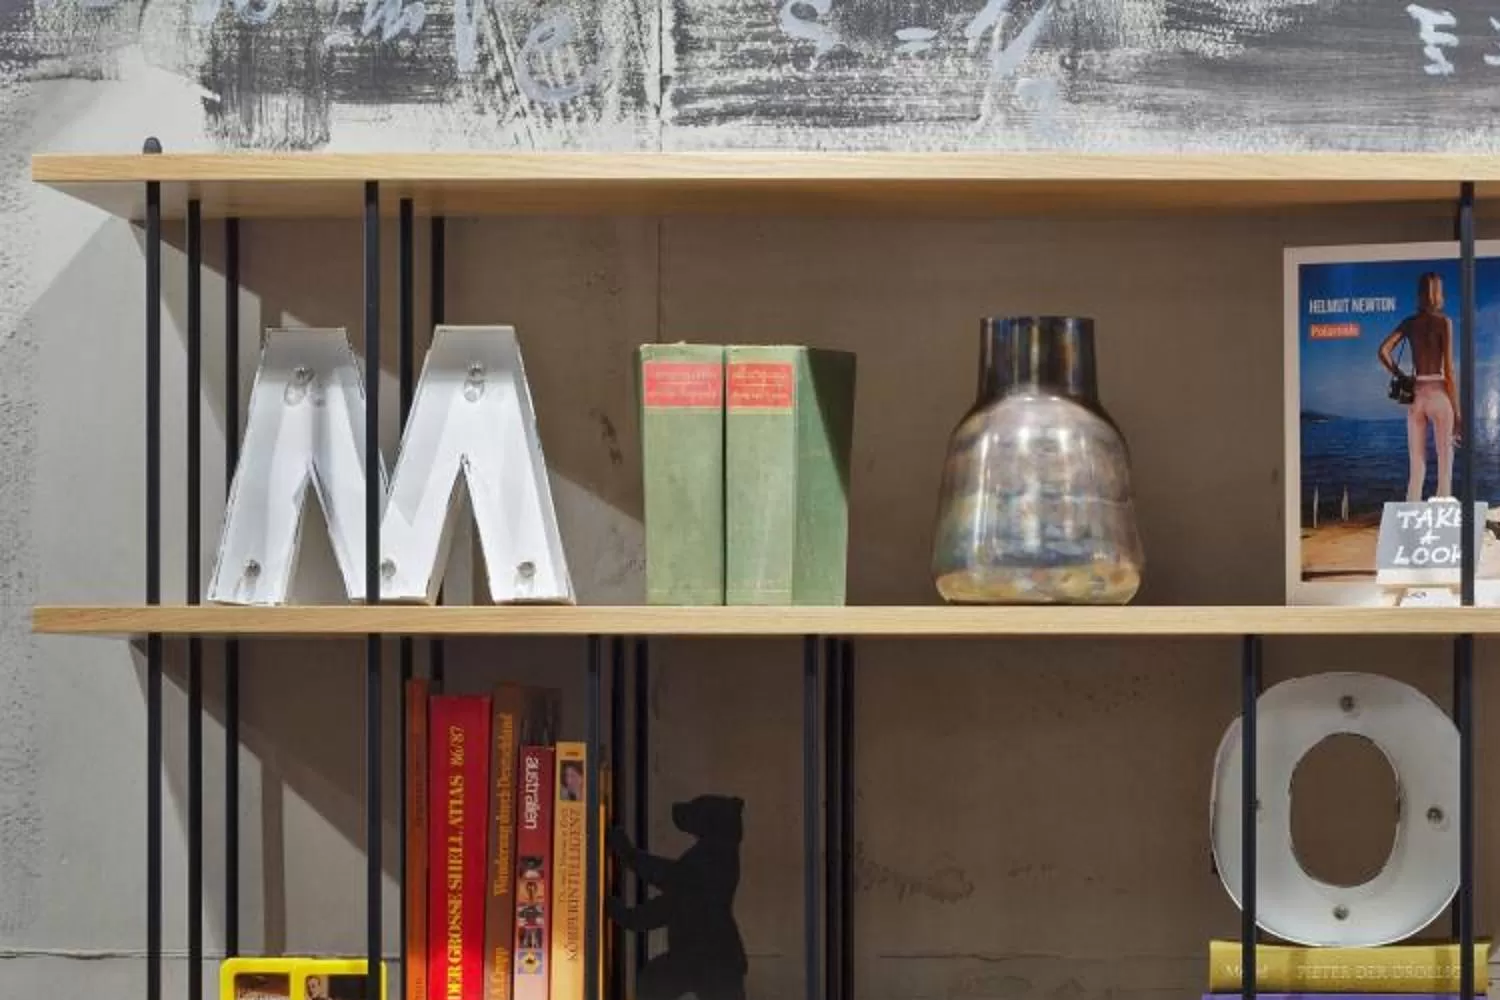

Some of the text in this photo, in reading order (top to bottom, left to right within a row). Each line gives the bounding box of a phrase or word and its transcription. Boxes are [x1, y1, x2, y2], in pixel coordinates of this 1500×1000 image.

[1309, 297, 1396, 313] HELMUT NEWTON
[448, 775, 464, 827] ATLAS
[525, 756, 541, 830] australien
[447, 832, 464, 890] SHELL
[447, 893, 463, 963] GROSSE
[447, 966, 463, 1000] DER
